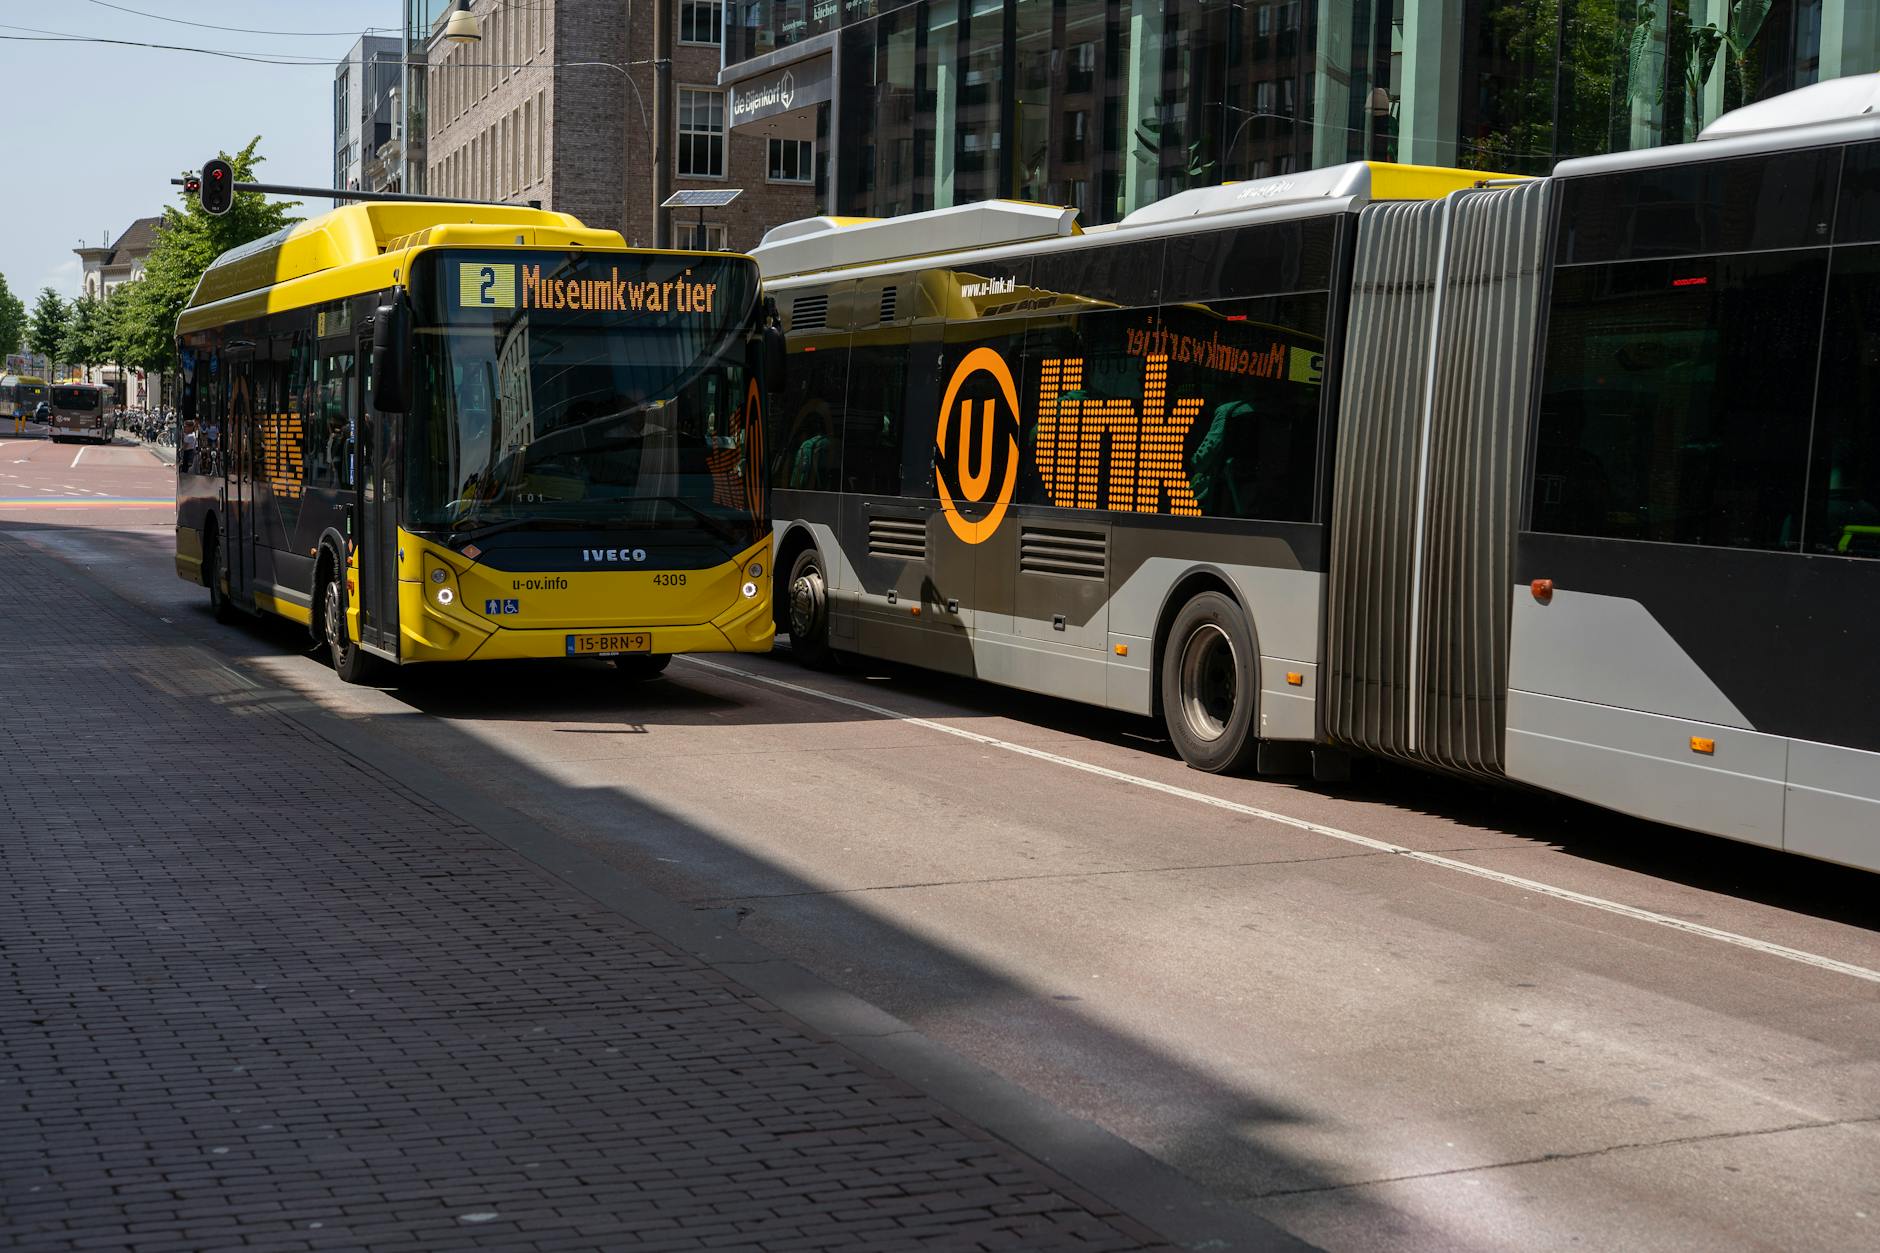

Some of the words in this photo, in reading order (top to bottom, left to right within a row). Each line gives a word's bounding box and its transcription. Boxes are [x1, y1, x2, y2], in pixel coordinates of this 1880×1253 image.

[813, 4, 838, 21] kitchen
[734, 93, 745, 115] de
[745, 82, 781, 115] Bijenkorf
[480, 266, 496, 304] 2
[522, 264, 717, 313] Museumkwartier
[961, 275, 1016, 298] www.u-link.nl
[1036, 354, 1204, 517] link
[582, 548, 647, 563] IVECO
[512, 576, 568, 591] u-ov.info
[652, 573, 688, 587] 4309
[579, 635, 644, 651] 15-BRN-9
